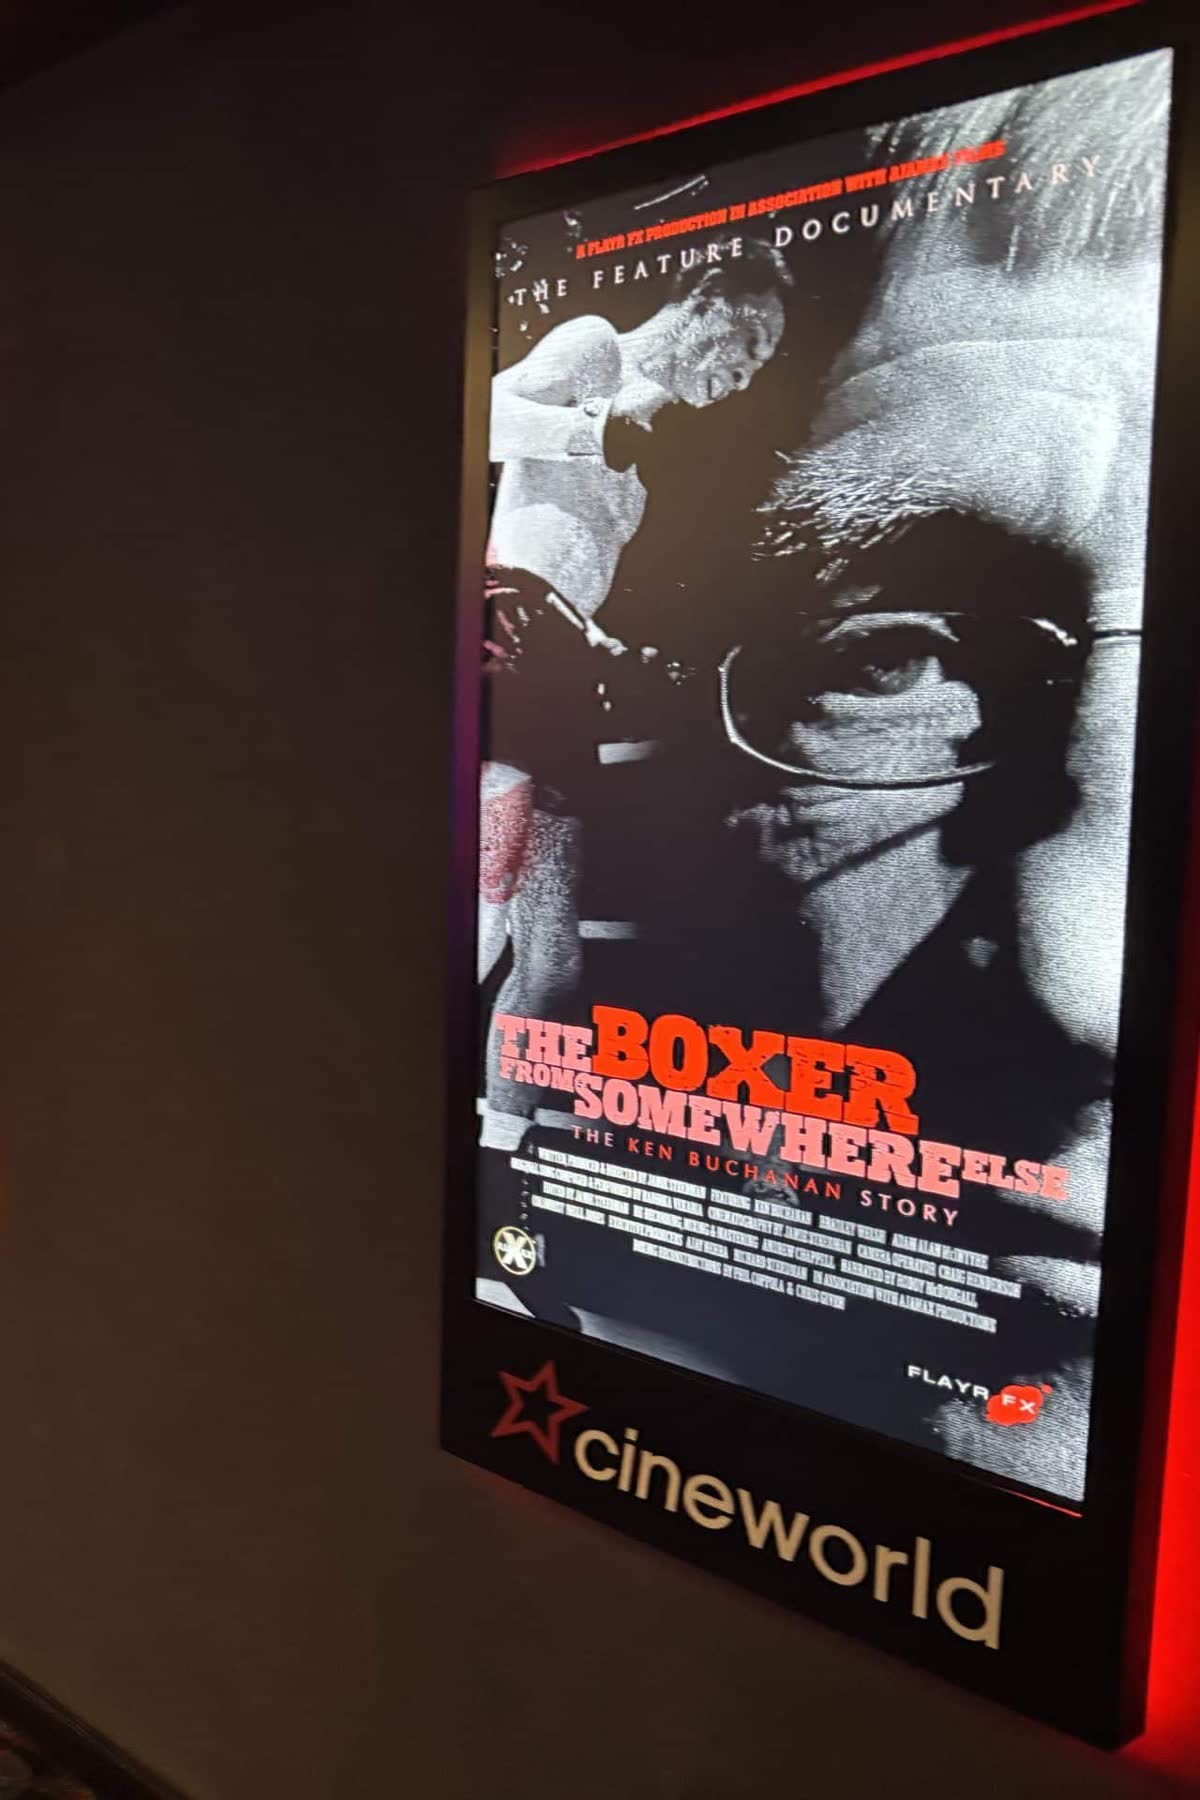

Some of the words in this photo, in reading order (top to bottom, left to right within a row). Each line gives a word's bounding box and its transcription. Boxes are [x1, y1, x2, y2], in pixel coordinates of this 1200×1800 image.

[514, 279, 568, 306] THE
[592, 237, 743, 289] FEATURE
[775, 155, 1100, 248] DOCUMENTARY
[646, 207, 728, 242] PRODUCTION
[729, 203, 746, 221] IN
[747, 179, 844, 218] ASSOCIATION
[496, 1013, 593, 1072] THE
[591, 1004, 919, 1135] BOXER
[499, 1058, 575, 1092] FROM
[572, 1073, 965, 1198] SOMEWHERE
[962, 1148, 1070, 1201] ELSE
[571, 1123, 615, 1148] THE
[628, 1136, 673, 1161] KEN
[689, 1148, 843, 1200] BUCHANAN
[860, 1189, 960, 1227] STORY
[907, 1365, 989, 1400] FLAYR
[1002, 1394, 1037, 1415] FX
[573, 1427, 1005, 1650] cineworld
